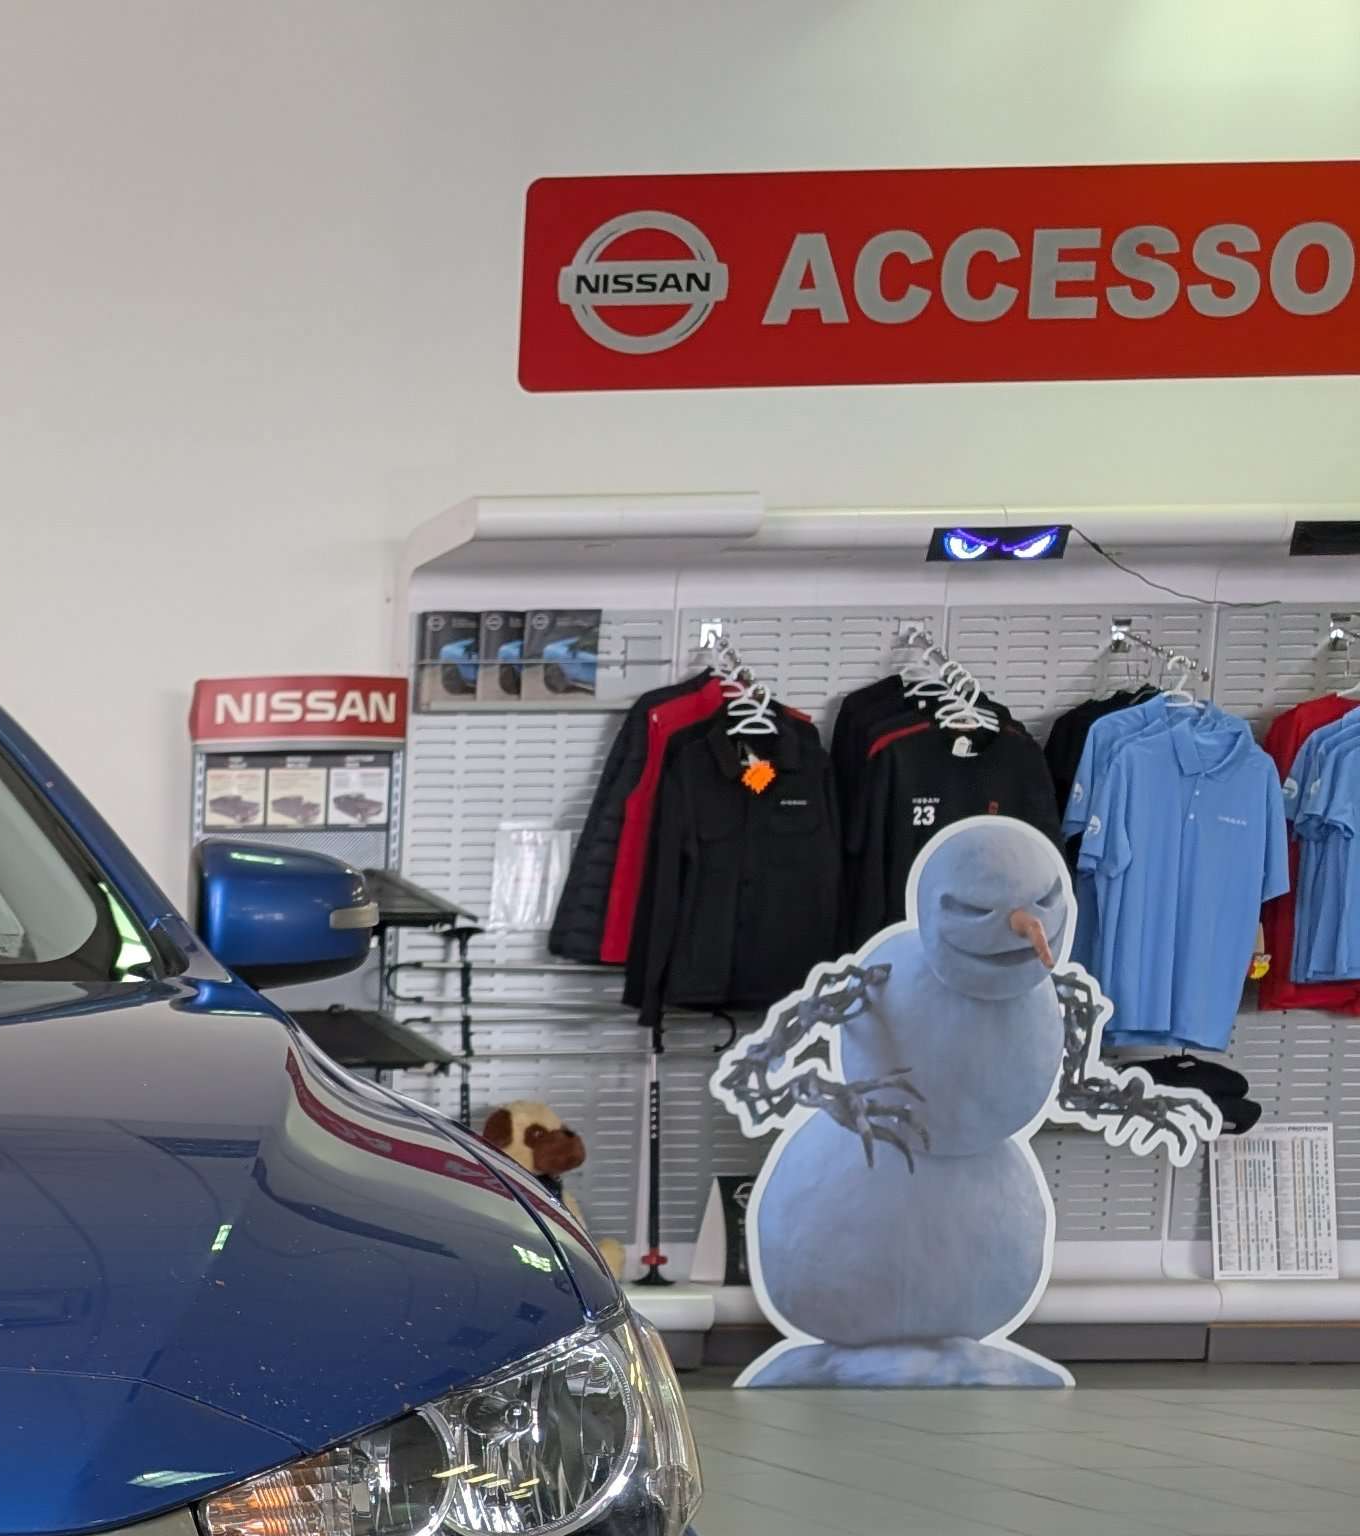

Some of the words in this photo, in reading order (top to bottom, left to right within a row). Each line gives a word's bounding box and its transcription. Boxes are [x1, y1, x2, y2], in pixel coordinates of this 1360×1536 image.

[575, 271, 711, 294] NISSAN
[762, 221, 1356, 325] ACCESSO
[214, 691, 396, 725] NISSAN
[913, 805, 935, 826] 23
